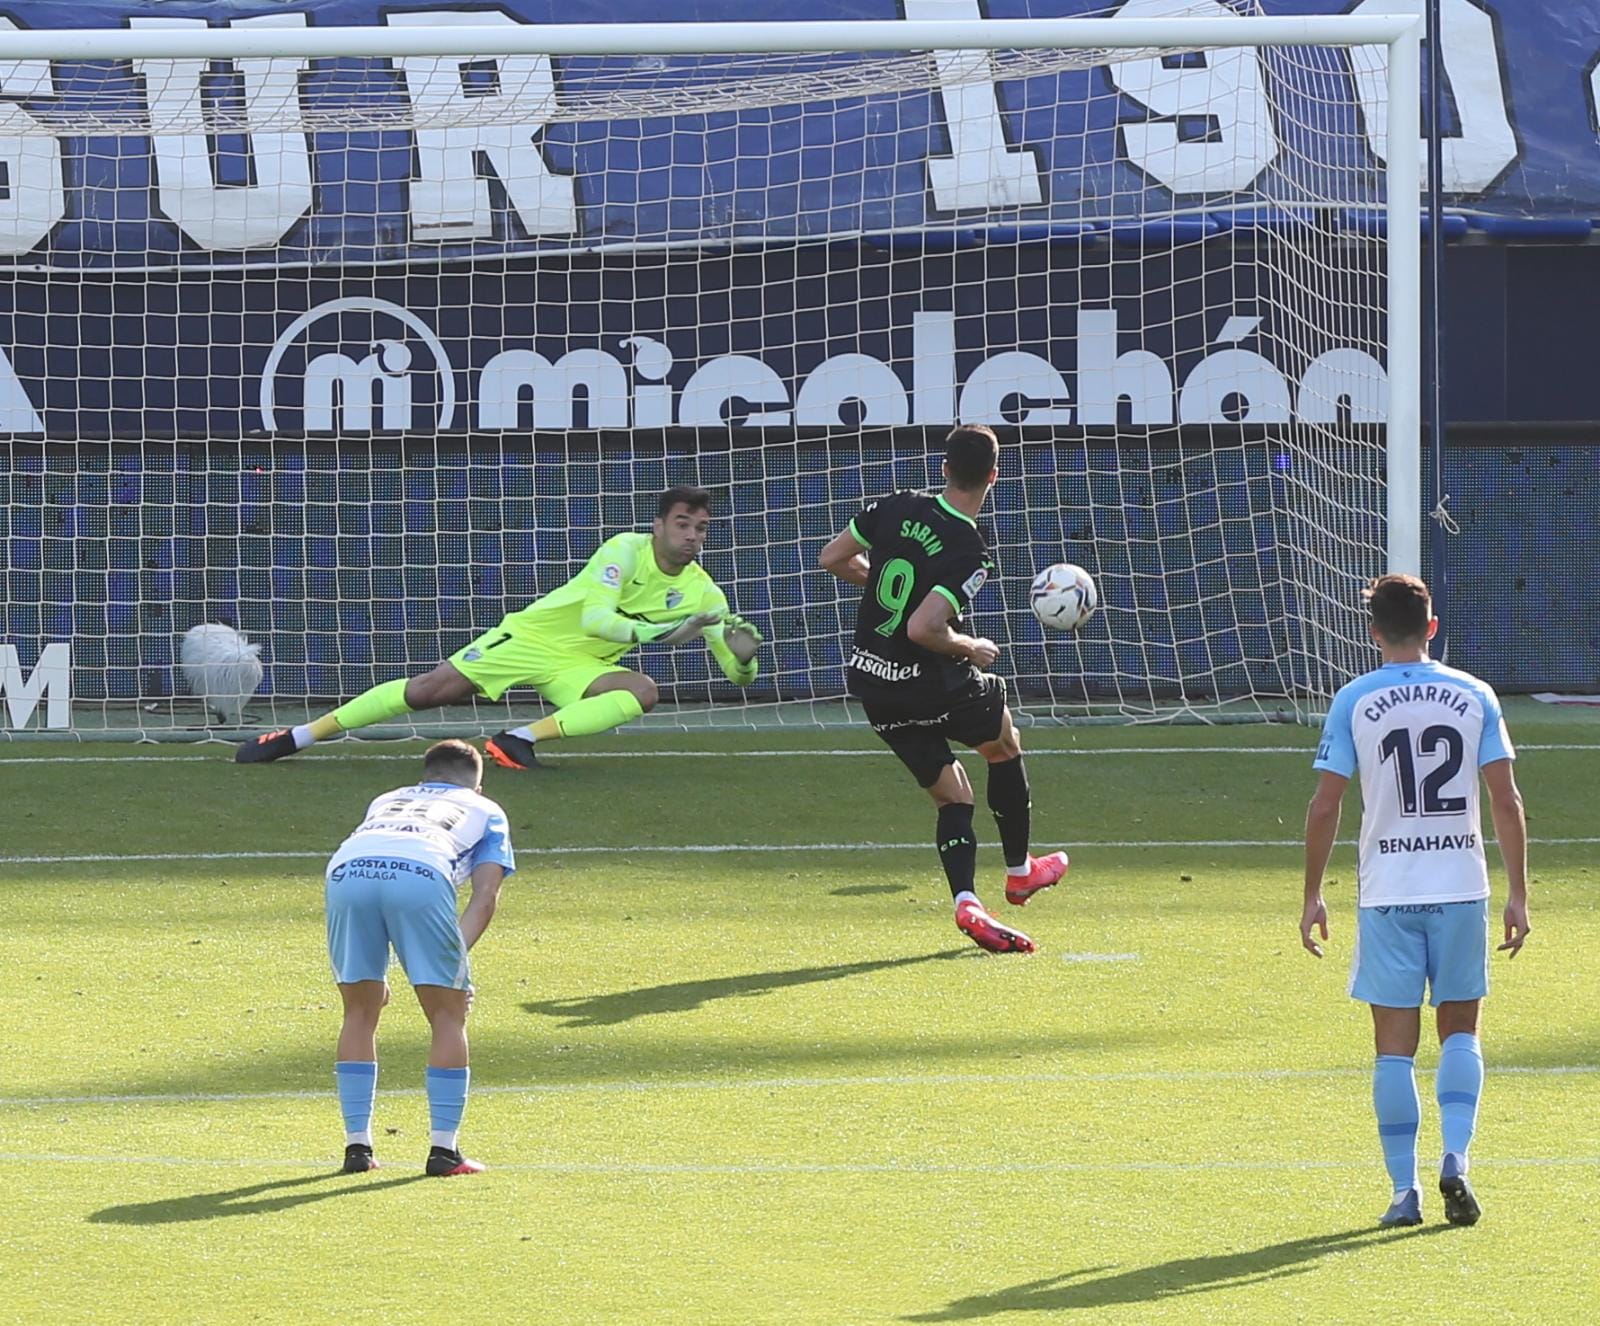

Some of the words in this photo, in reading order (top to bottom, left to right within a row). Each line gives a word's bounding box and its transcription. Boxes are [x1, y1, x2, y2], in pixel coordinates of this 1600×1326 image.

[478, 308, 1388, 430] micolchón
[900, 519, 944, 557] SABIN
[874, 557, 915, 638] 9
[1364, 684, 1471, 723] CHAVARRÍA
[1377, 724, 1468, 818] 12
[1378, 833, 1477, 855] BENAHAVIS
[348, 868, 398, 881] MÁLAGA
[349, 859, 388, 870] COSTA
[390, 861, 412, 873] DEL
[415, 866, 436, 881] SOL
